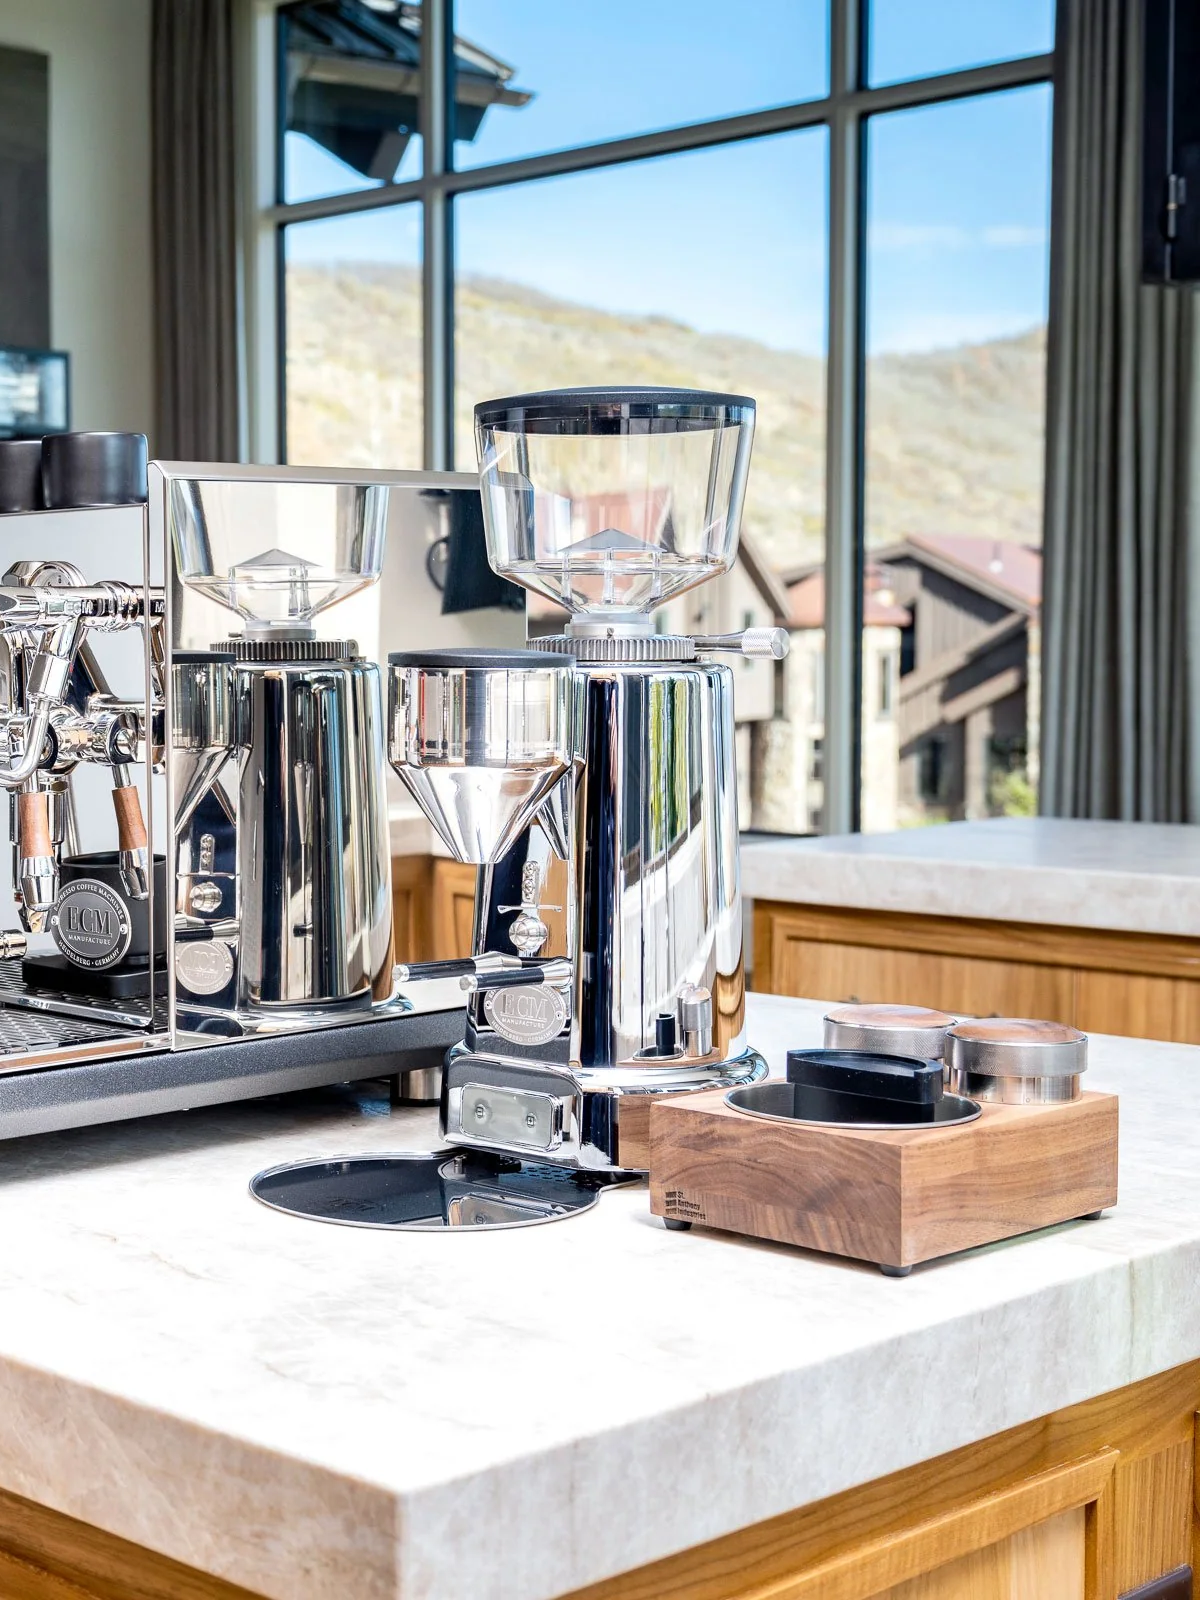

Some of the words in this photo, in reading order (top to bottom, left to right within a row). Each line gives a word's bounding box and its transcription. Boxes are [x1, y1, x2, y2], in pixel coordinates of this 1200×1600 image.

[76, 883, 98, 892] COFFEE
[98, 887, 125, 919] MACHINES
[67, 905, 113, 935] ECM
[58, 940, 91, 966] HEIDELBERG
[95, 947, 120, 966] GERMANY
[68, 934, 111, 946] MANUFACTURE
[502, 994, 548, 1020] ECM
[502, 1017, 545, 1029] MANUFACTURE
[677, 1199, 700, 1210] Anthony
